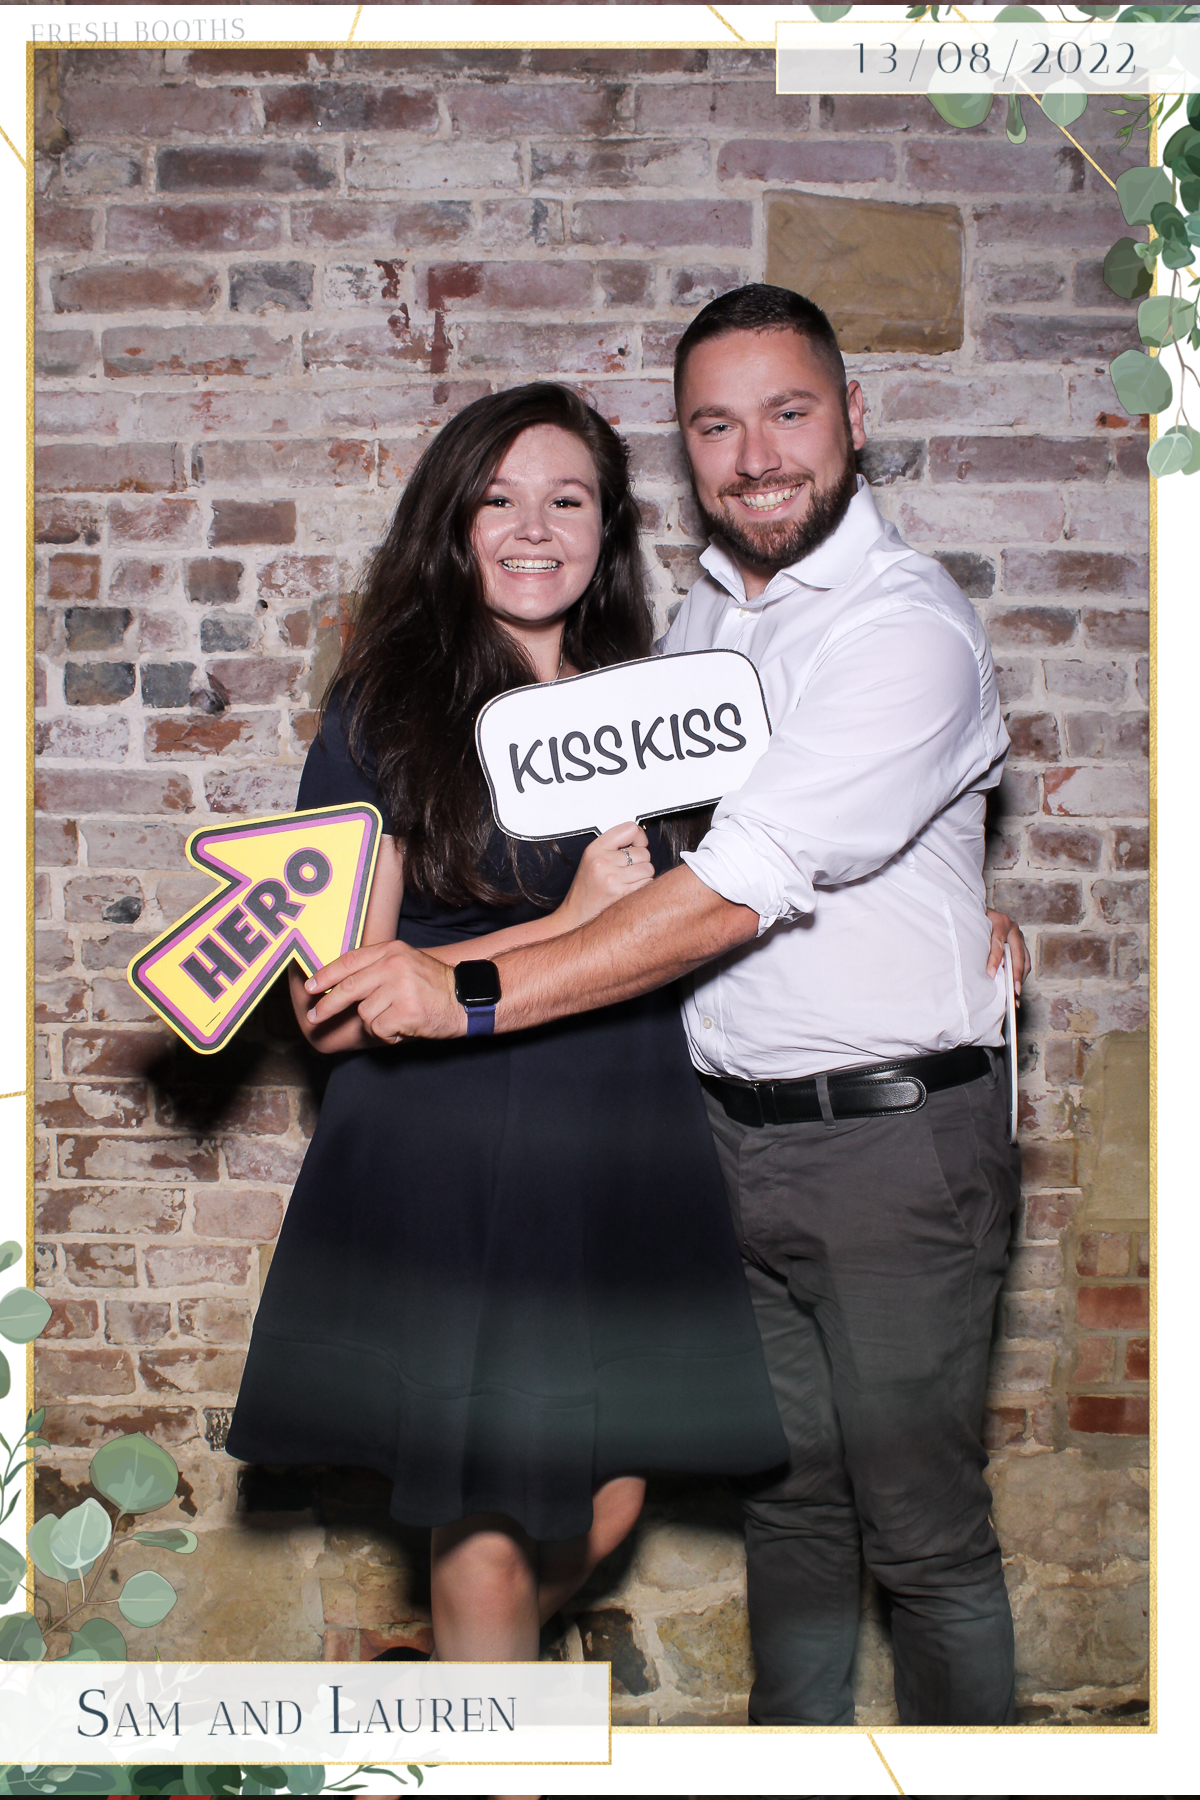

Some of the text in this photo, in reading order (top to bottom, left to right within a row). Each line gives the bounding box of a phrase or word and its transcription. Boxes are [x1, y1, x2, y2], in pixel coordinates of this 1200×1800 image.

[509, 702, 747, 793] KISS KISS
[178, 847, 333, 1003] HERO
